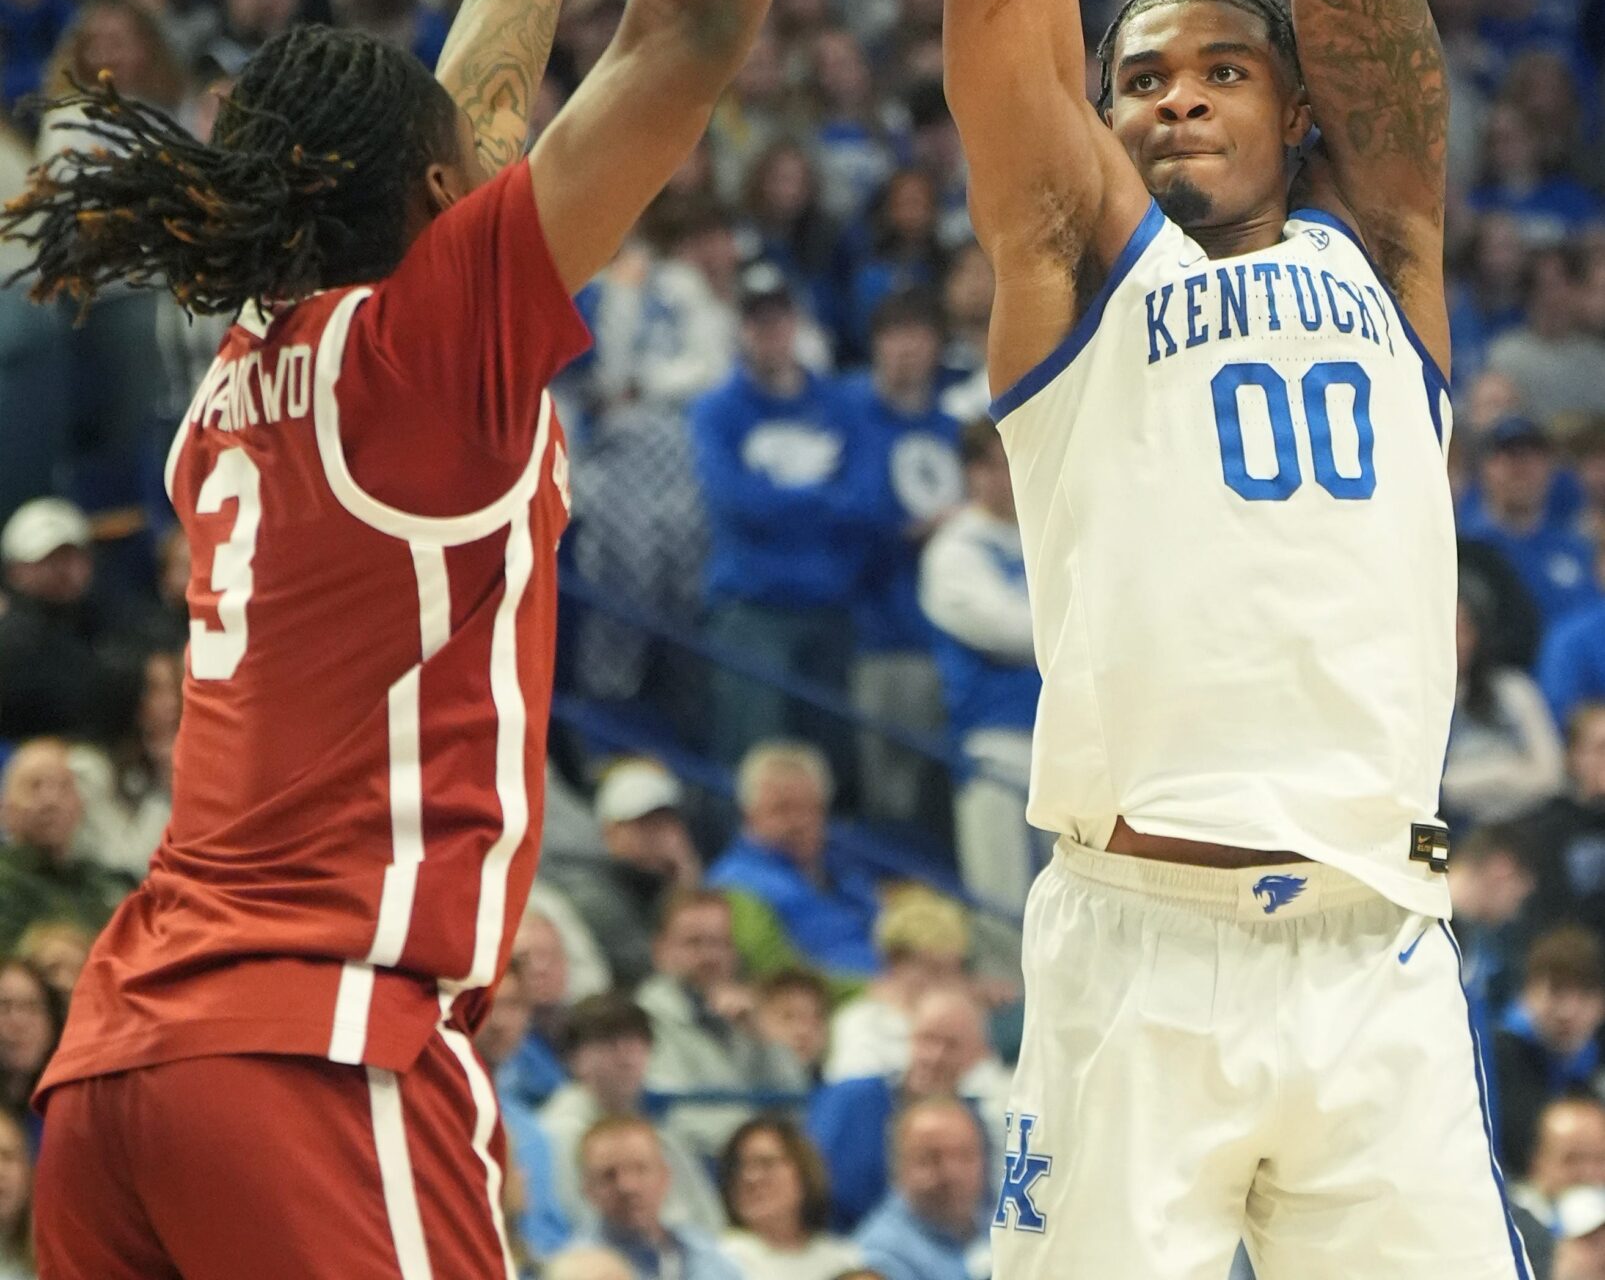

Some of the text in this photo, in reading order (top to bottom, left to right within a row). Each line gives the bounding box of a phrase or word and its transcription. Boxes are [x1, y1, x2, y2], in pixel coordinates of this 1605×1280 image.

[1145, 263, 1394, 365] KENTUCKY
[1210, 361, 1377, 501] 00
[189, 446, 262, 680] 3
